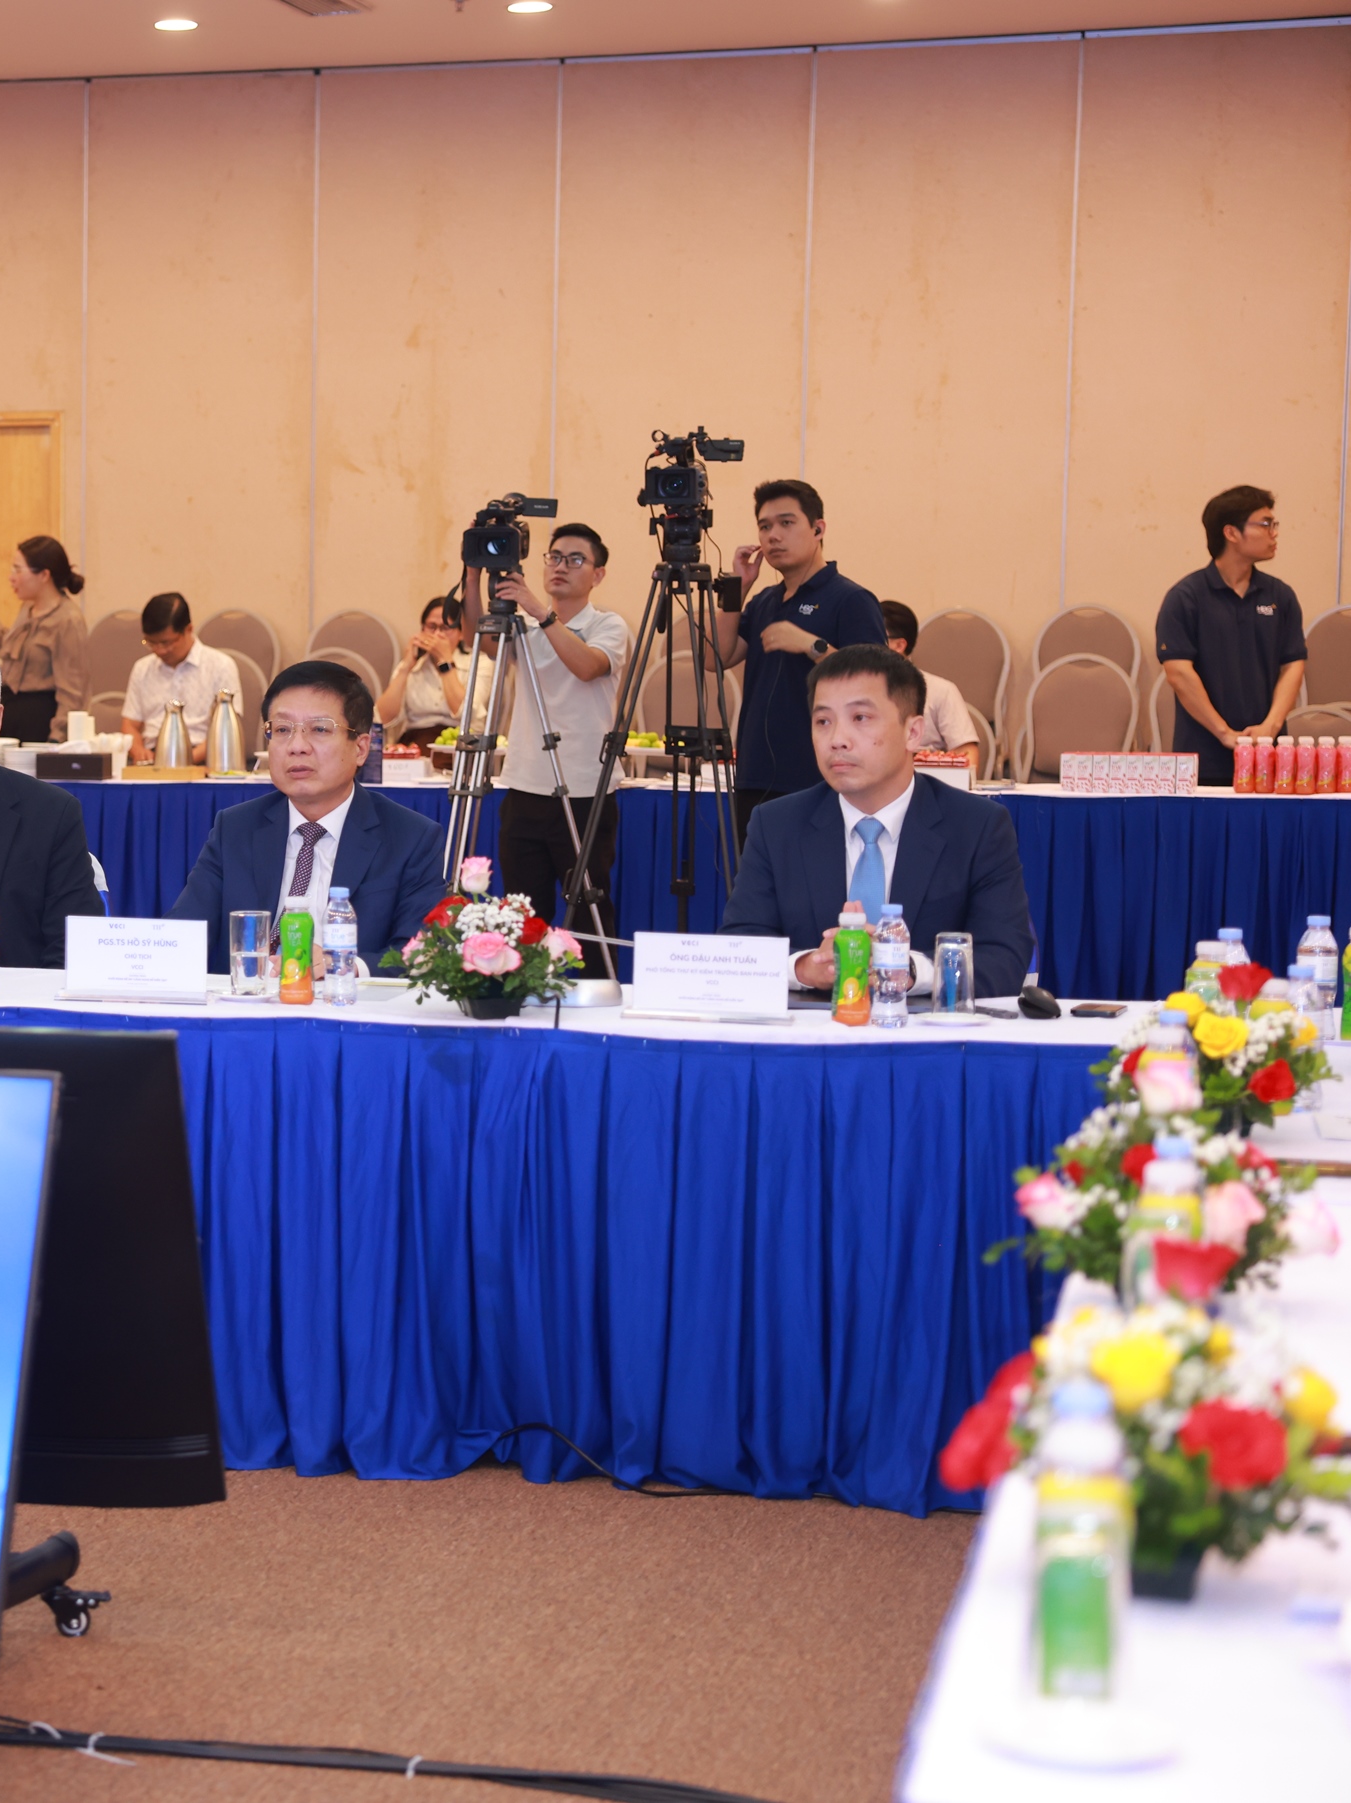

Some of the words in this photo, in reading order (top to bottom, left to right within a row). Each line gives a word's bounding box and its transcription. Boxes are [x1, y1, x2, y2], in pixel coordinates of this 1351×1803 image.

[98, 938, 126, 946] PGS.TS
[127, 937, 140, 946] HỒ
[142, 938, 151, 947] SỸ
[153, 939, 178, 948] HÙNG
[670, 953, 690, 962] ÔNG
[692, 954, 710, 963] ĐẬU
[733, 955, 757, 964] TUẤN
